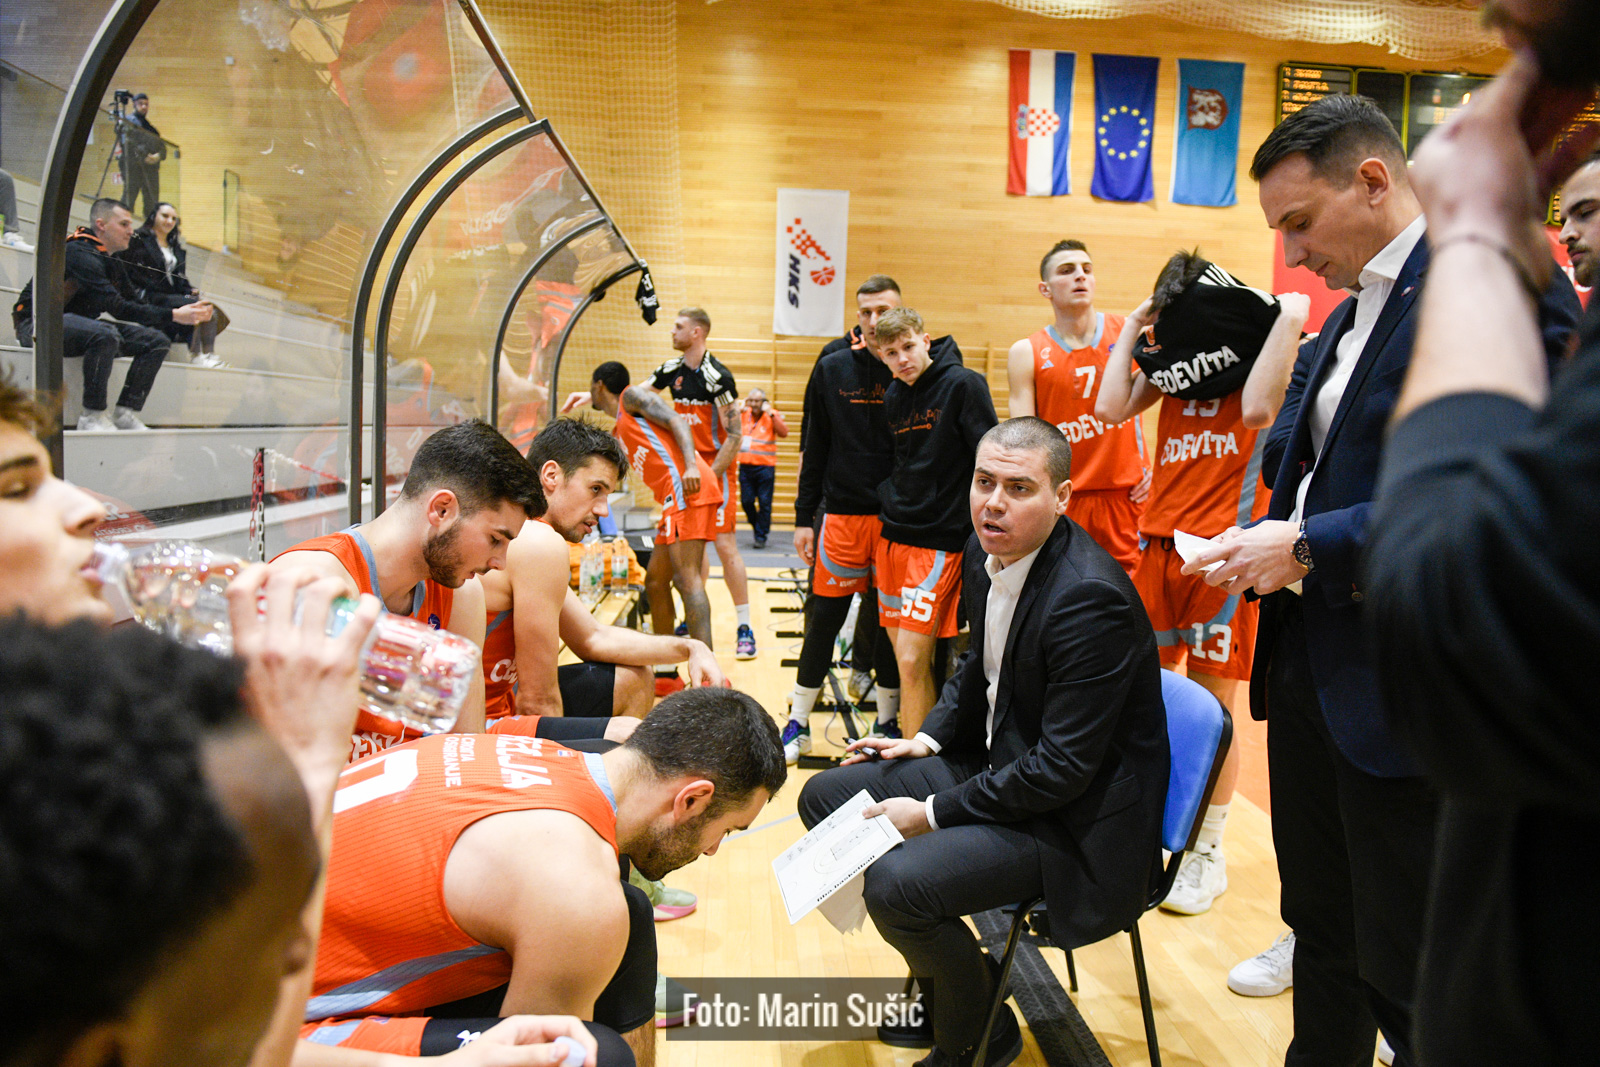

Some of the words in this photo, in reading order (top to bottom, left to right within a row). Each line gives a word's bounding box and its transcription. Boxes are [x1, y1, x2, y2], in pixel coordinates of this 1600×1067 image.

[788, 253, 800, 309] HKS
[1075, 365, 1096, 399] 7
[1149, 345, 1241, 394] EDEVITA
[900, 586, 937, 623] 55
[1191, 622, 1232, 663] 13
